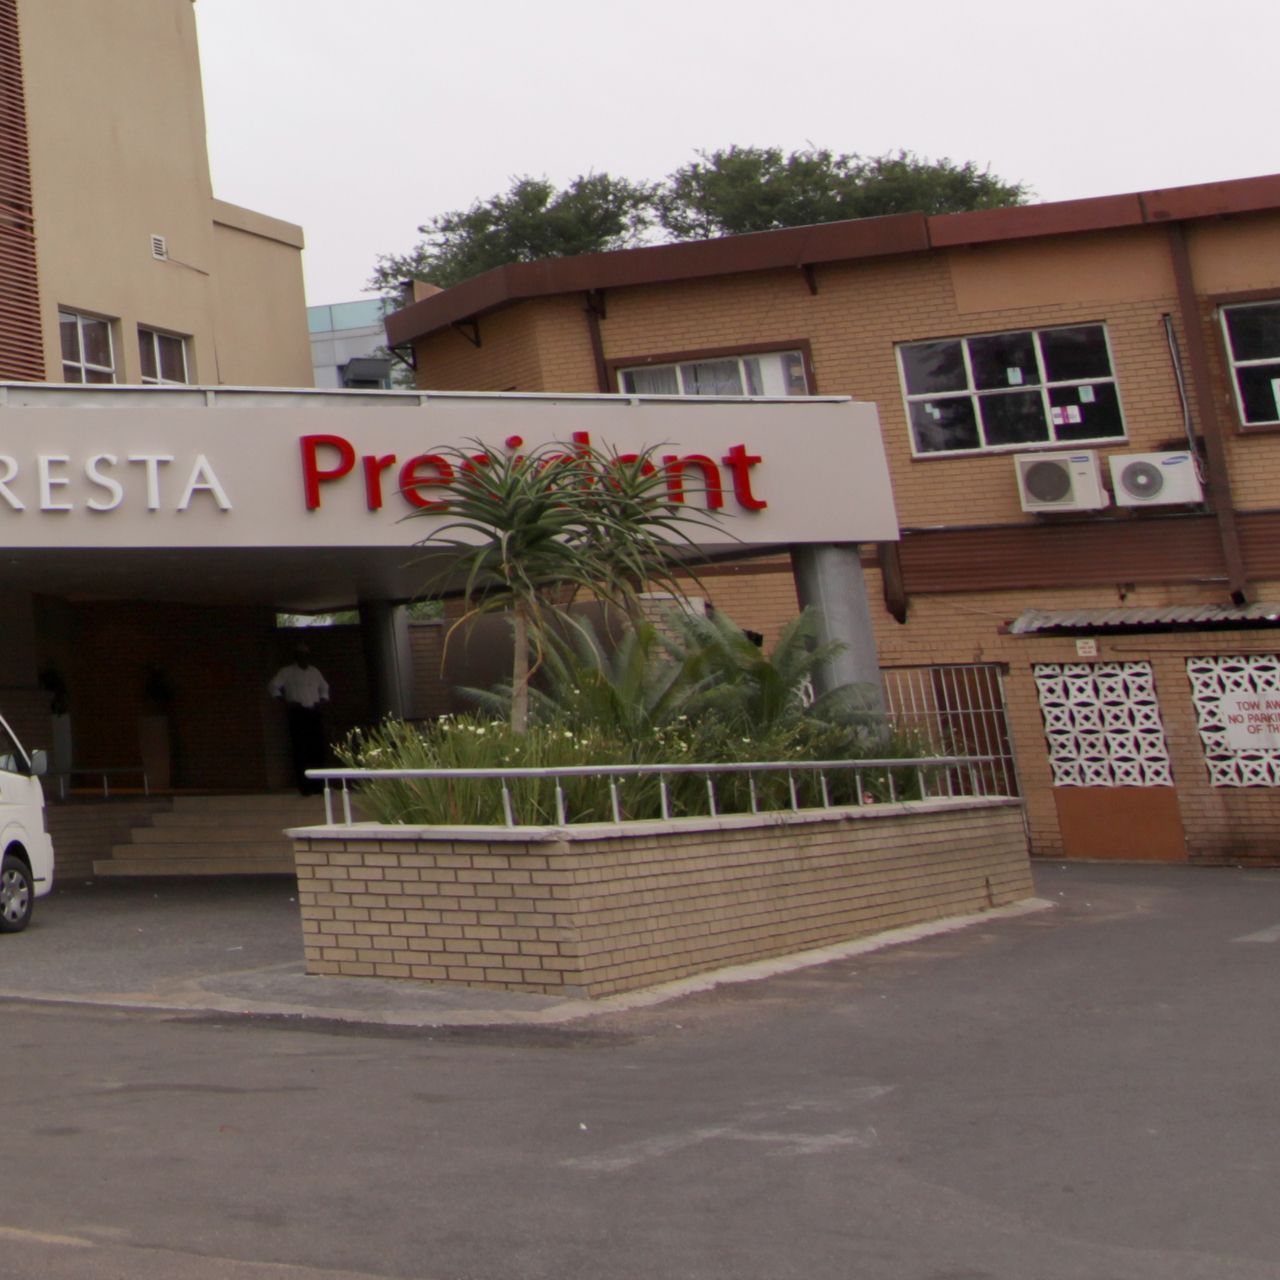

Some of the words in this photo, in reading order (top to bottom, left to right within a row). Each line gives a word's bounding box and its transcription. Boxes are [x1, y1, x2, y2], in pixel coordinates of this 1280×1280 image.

[1236, 701, 1260, 711] TOW
[1228, 714, 1244, 724] NO
[1247, 724, 1263, 734] OF
